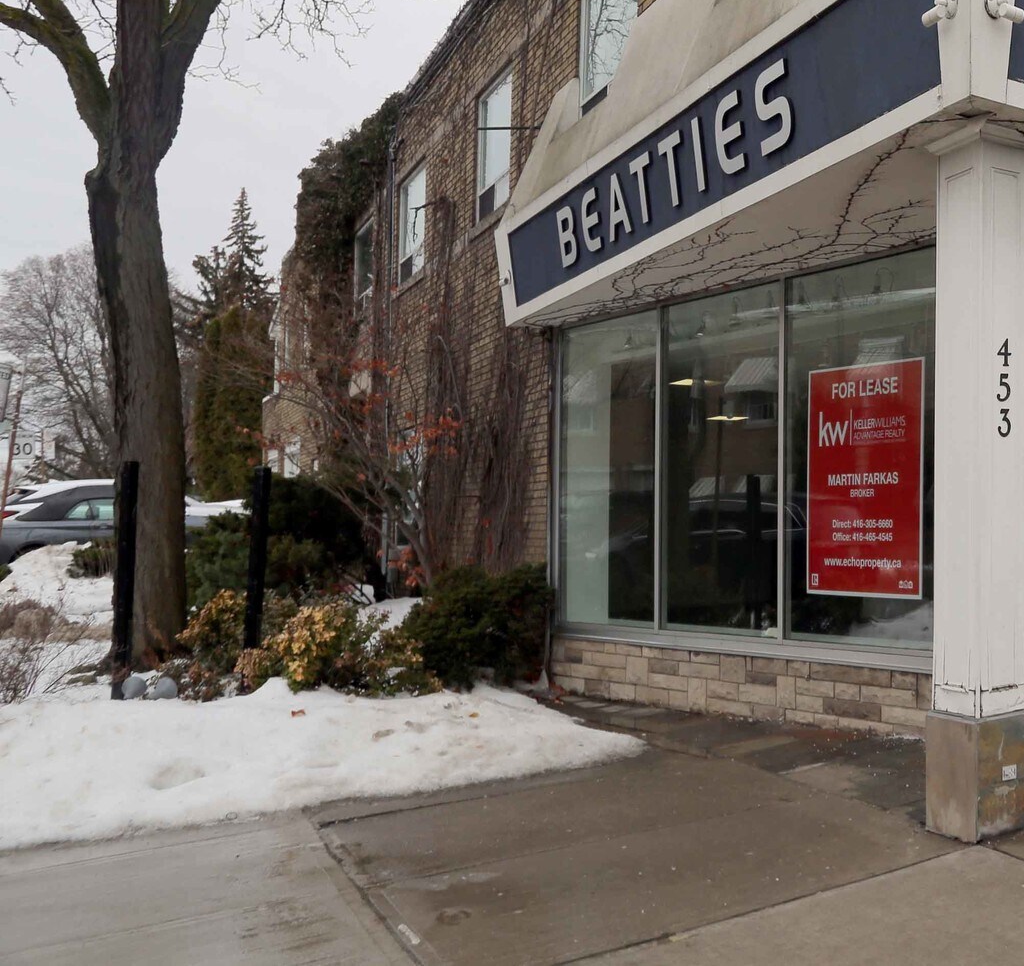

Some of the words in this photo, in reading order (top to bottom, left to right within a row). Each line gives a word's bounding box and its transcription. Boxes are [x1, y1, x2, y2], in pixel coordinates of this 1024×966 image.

[555, 58, 793, 269] BEATTIES
[832, 382, 856, 400] FOR
[859, 377, 898, 397] LEASE
[819, 411, 849, 448] kw
[853, 430, 884, 441] ADVANTAGE
[885, 428, 906, 438] REALTY
[828, 474, 861, 487] MARTIN
[863, 472, 899, 485] FARKAS
[850, 488, 875, 498] BROKER
[832, 520, 852, 529] Direct:
[832, 532, 852, 542] Office:
[852, 532, 893, 542] 416-465-4545
[824, 557, 902, 571] www.echoproperty.ca
